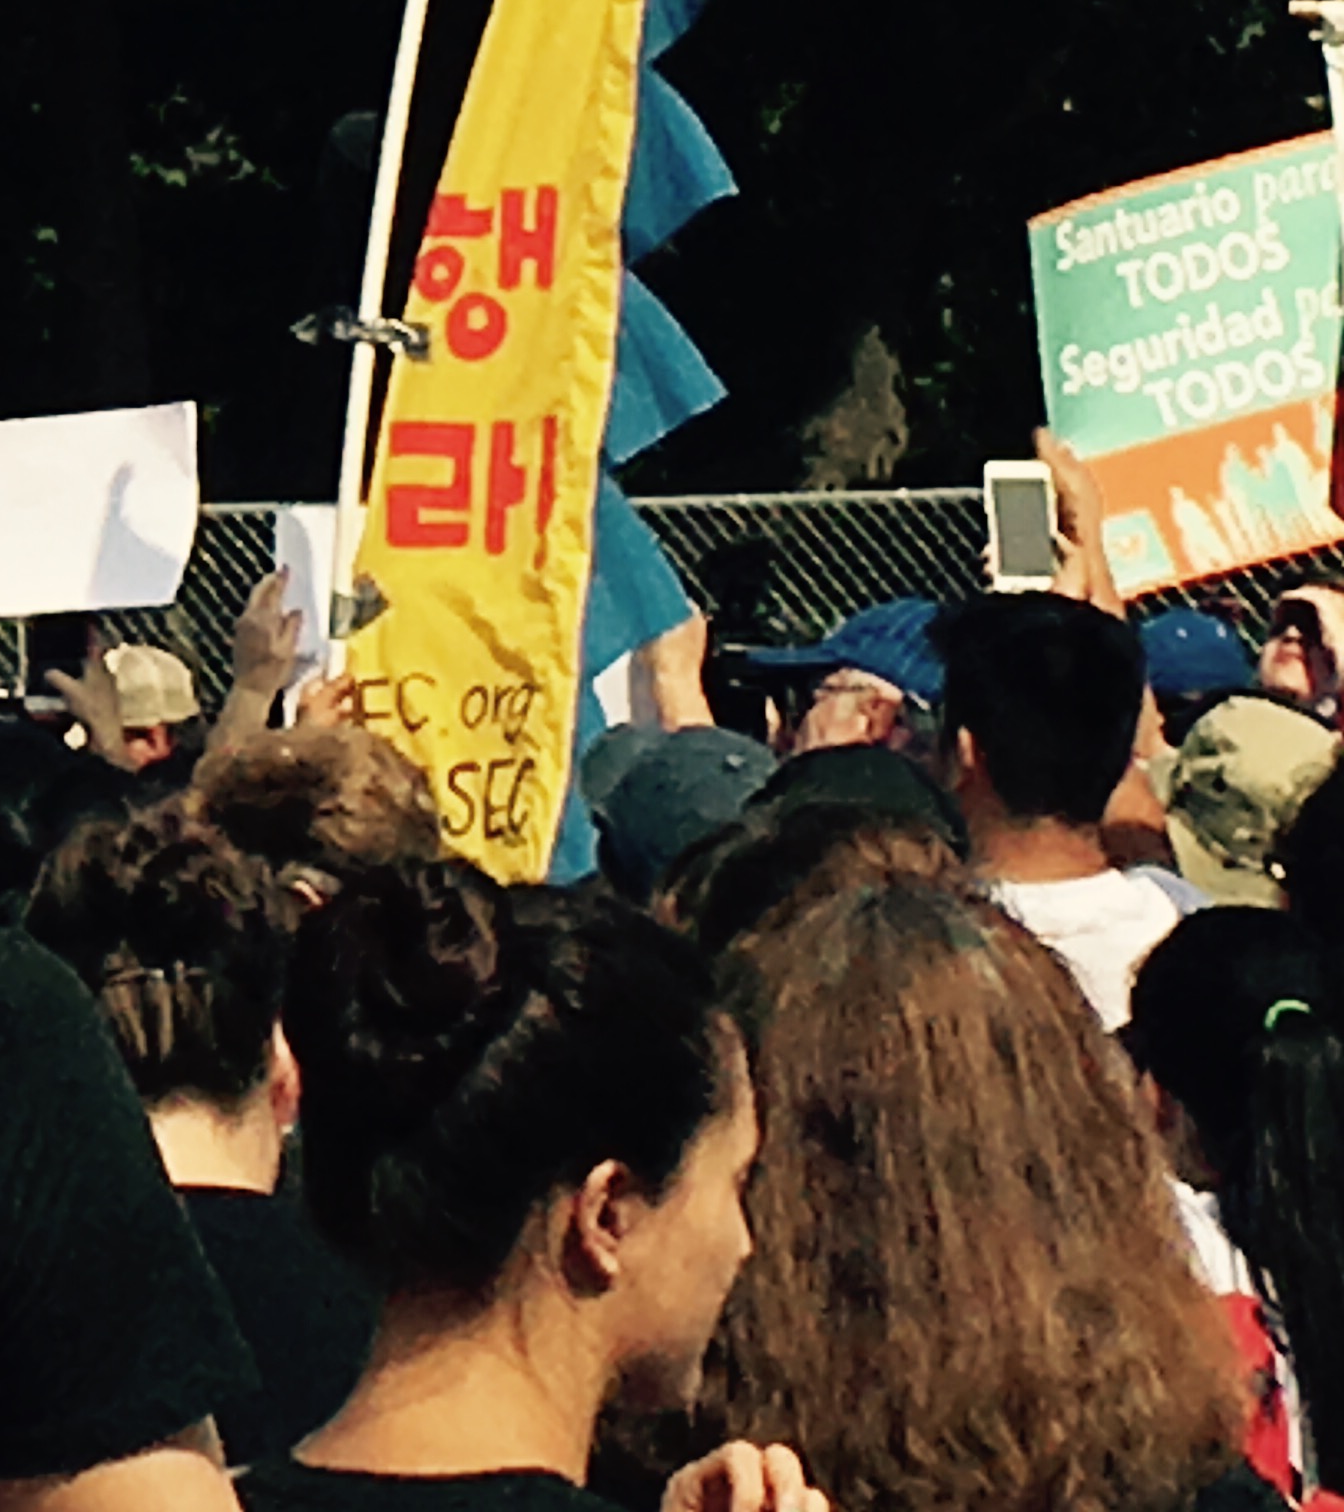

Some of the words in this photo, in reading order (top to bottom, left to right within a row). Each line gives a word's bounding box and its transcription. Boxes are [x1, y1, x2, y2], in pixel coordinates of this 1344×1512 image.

[1055, 181, 1241, 272] Santuario
[1115, 220, 1291, 309] TODOS
[1058, 286, 1286, 397] Seguridad
[1141, 338, 1326, 429] TODOS
